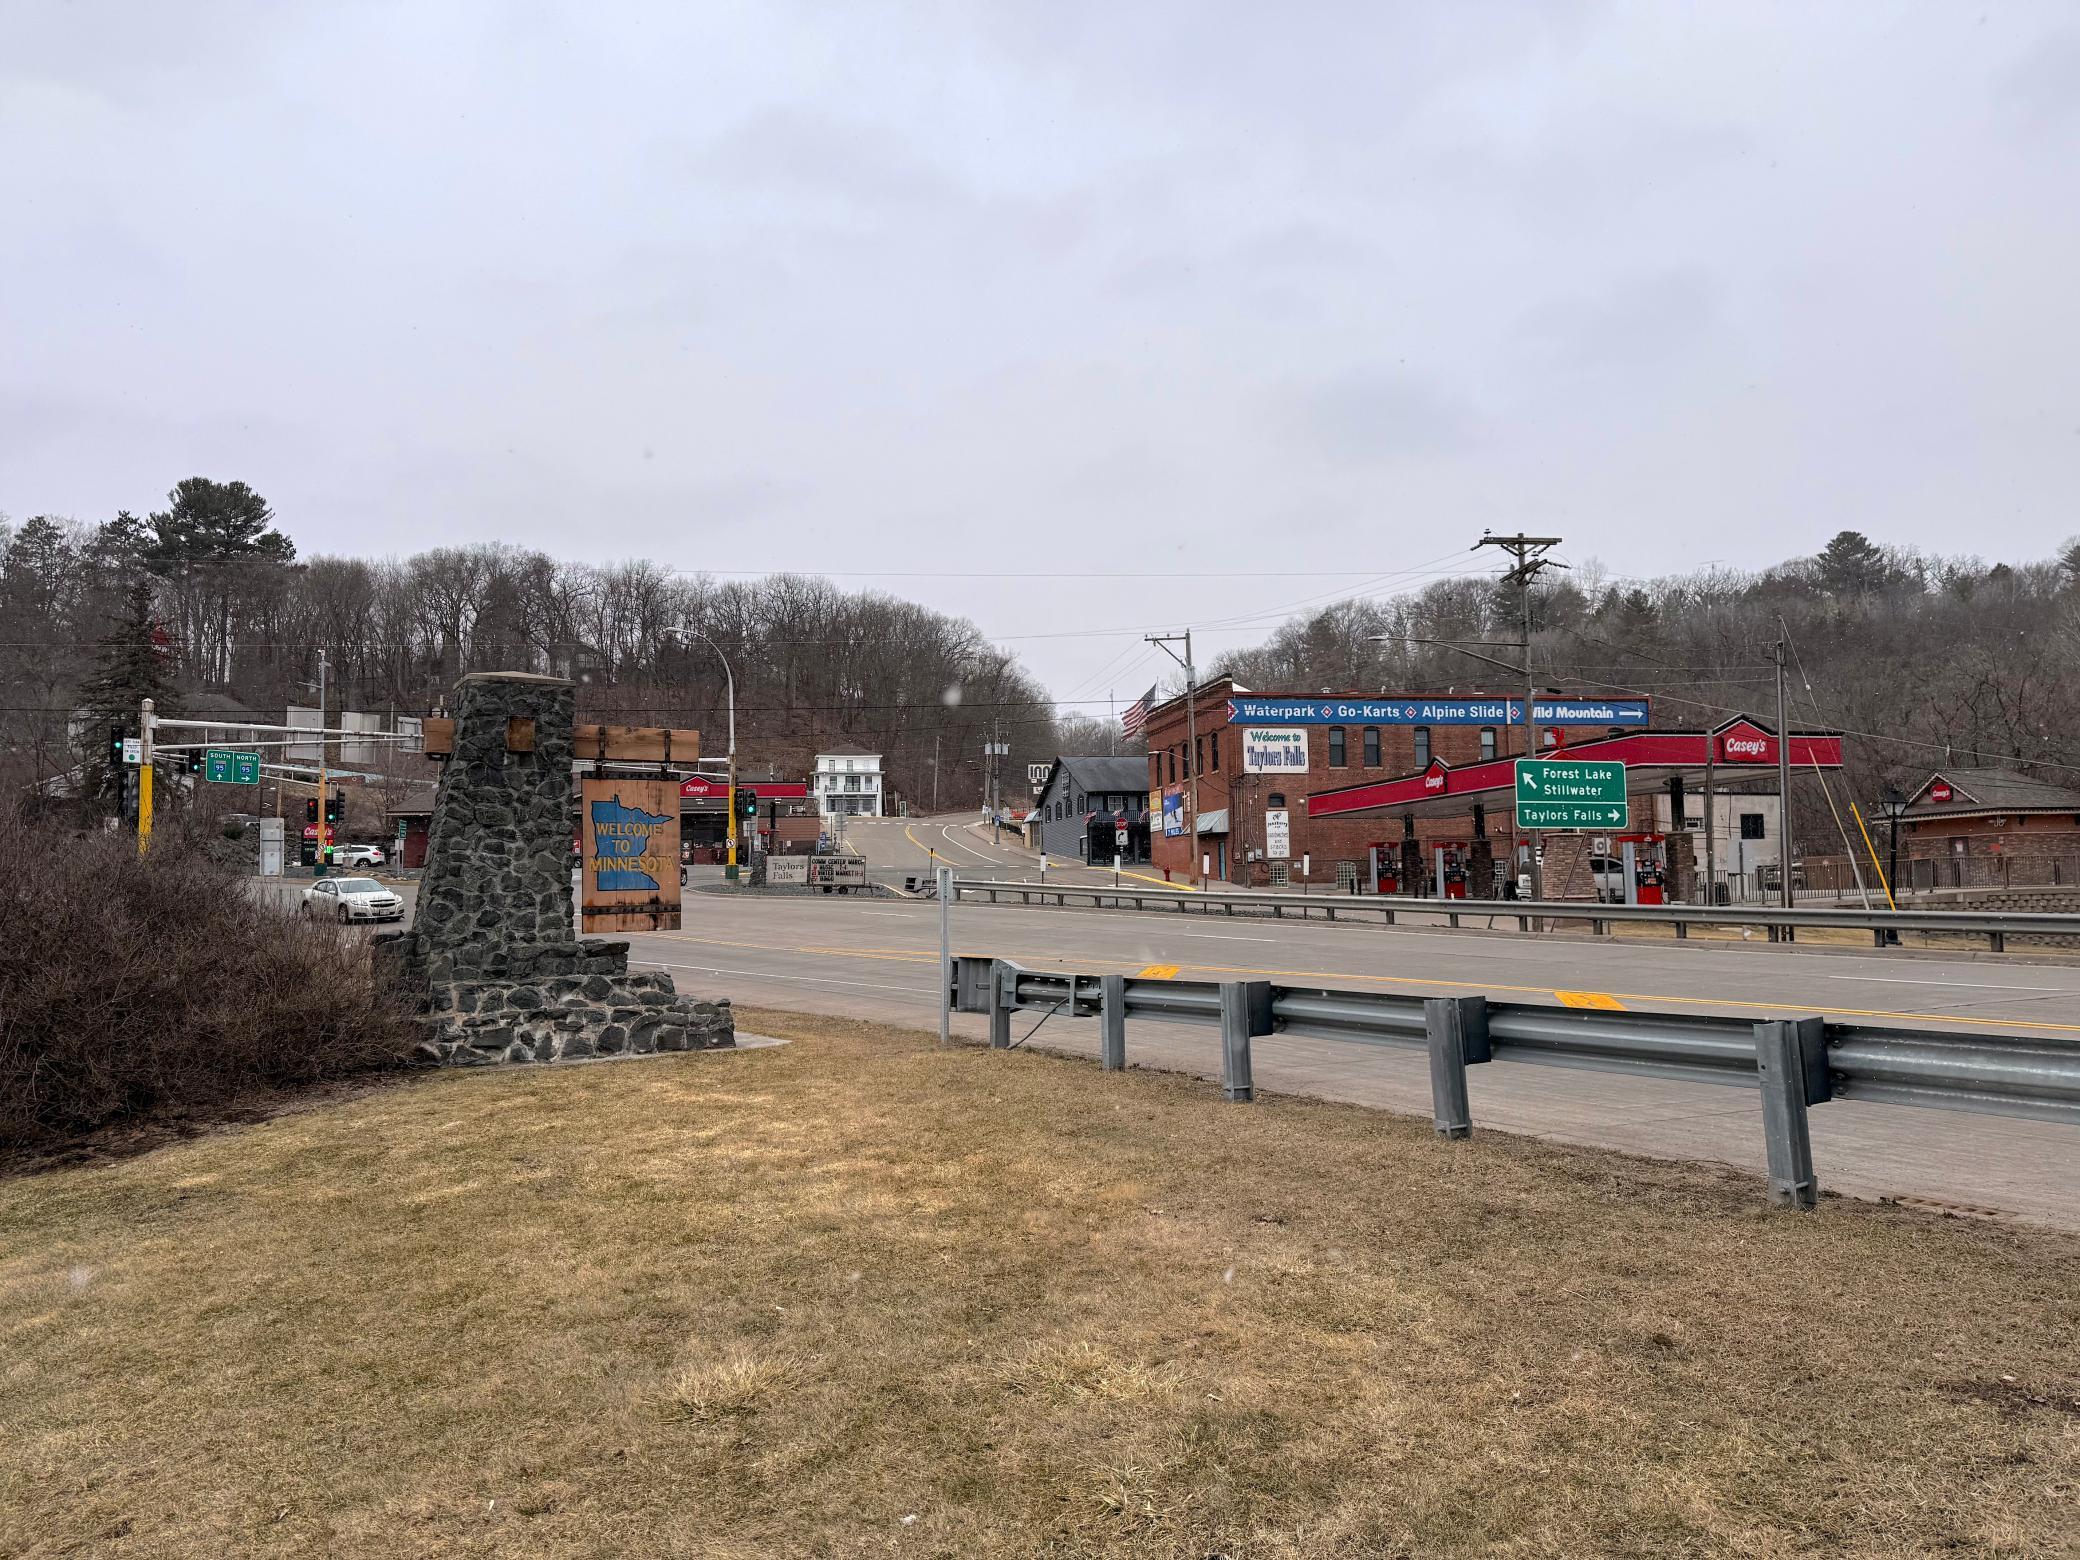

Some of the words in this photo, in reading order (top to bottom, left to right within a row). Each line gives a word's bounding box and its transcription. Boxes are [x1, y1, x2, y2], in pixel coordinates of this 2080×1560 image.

[1243, 704, 1315, 719] Waterpark
[1338, 705, 1400, 718] Go-Karts
[1422, 705, 1465, 720] Alpine
[1469, 705, 1504, 718] Slide
[1556, 706, 1614, 719] Mountain
[1250, 730, 1291, 742] Welcome
[1292, 733, 1301, 742] to
[1726, 737, 1766, 755] Casey's
[210, 752, 231, 760] SOUTH
[236, 754, 257, 762] NORTH
[1247, 745, 1282, 771] Taylors
[1283, 745, 1306, 767] Falls
[1543, 767, 1580, 779] Forest
[1585, 768, 1612, 780] Lake
[1425, 774, 1444, 788] Casey's
[685, 784, 709, 794] Casey's
[1544, 784, 1603, 796] Stillwater
[1524, 809, 1568, 822] Taylors
[1574, 809, 1602, 821] Falls
[596, 822, 664, 837] WELCOME
[611, 839, 631, 853] TO
[589, 856, 677, 873] MINNESOTA
[772, 862, 805, 871] Taylors
[772, 871, 793, 880] Falls
